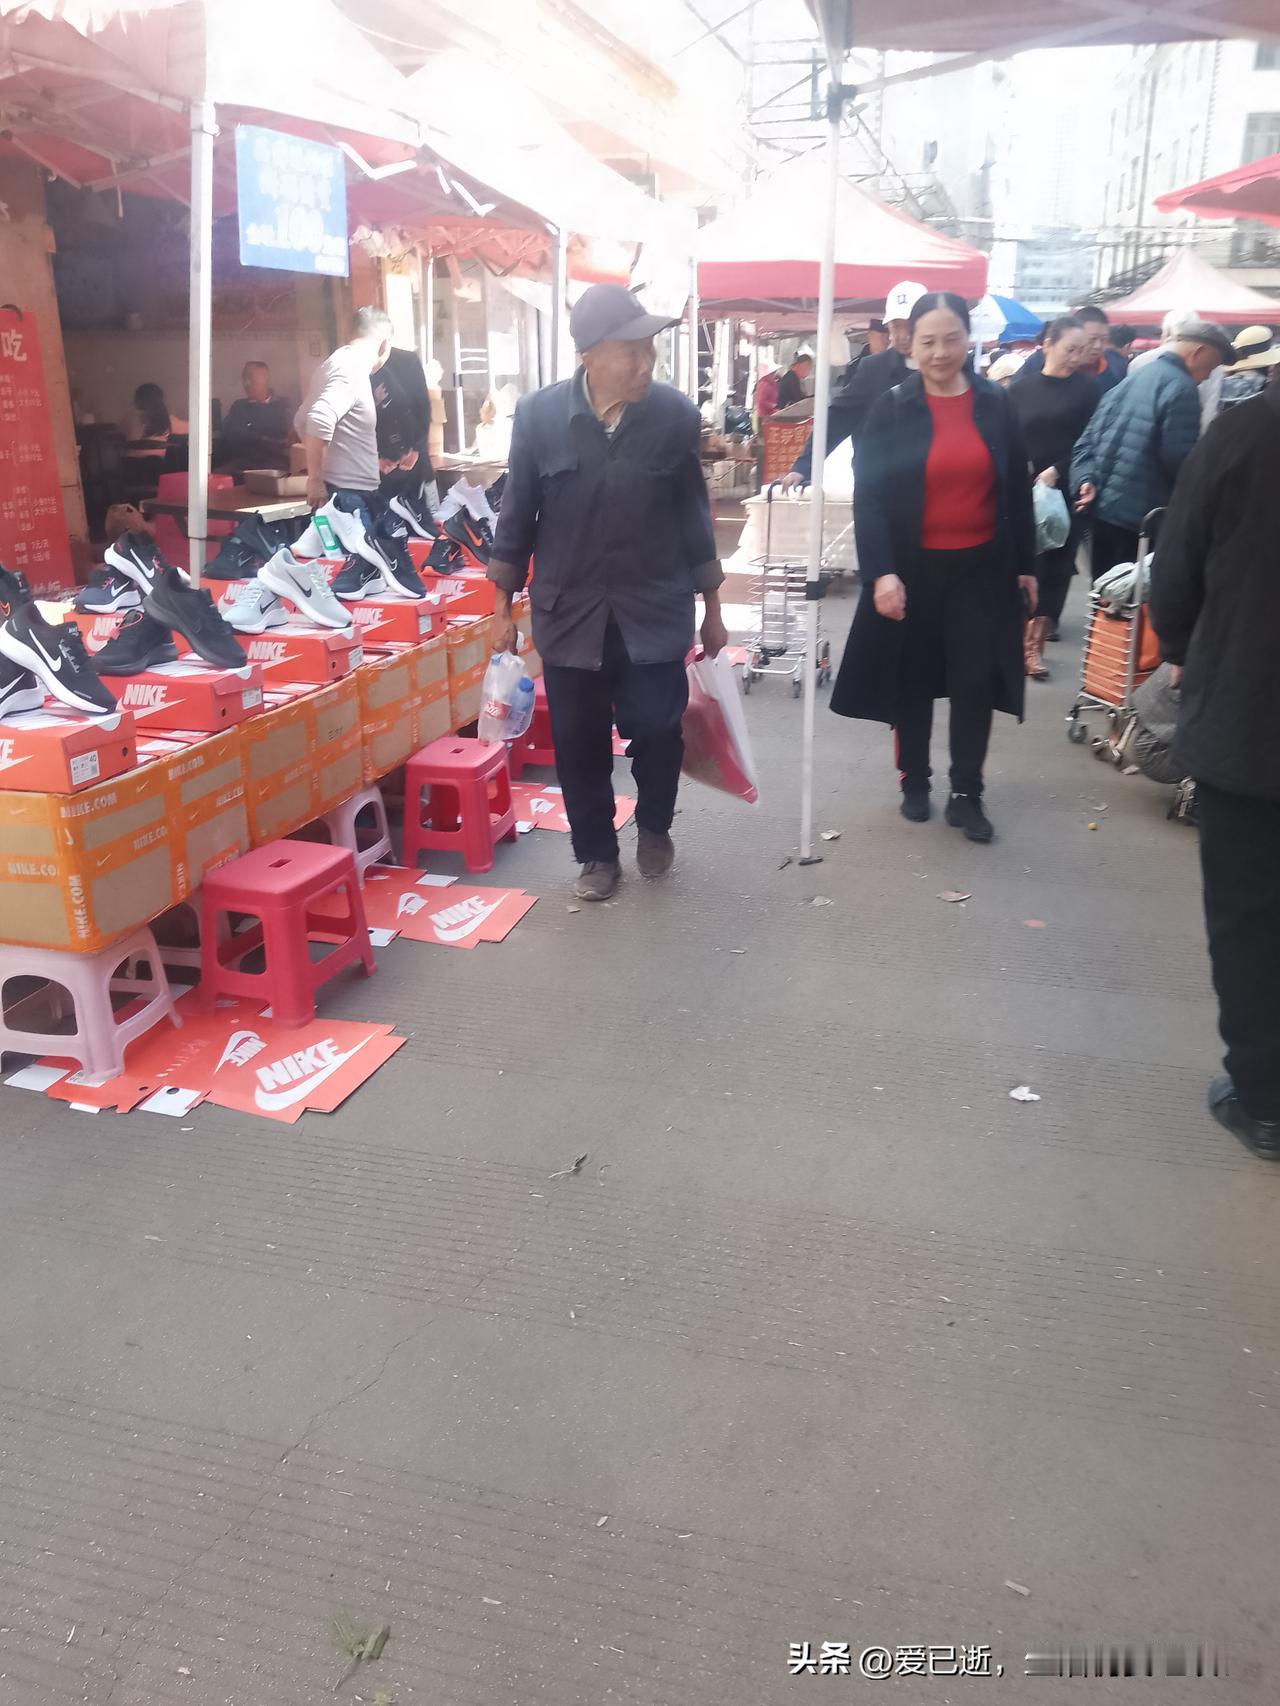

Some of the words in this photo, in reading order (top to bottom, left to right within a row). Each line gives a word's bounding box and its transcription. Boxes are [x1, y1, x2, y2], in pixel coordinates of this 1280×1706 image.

[1, 328, 27, 361] 吃
[352, 607, 384, 625] NIKE
[247, 641, 287, 660] NIKE
[123, 683, 168, 705] NIKE
[60, 792, 118, 818] NIKE.COM
[69, 874, 91, 939] NIKE.COM
[429, 895, 486, 929] NIKE
[256, 1038, 345, 1091] NIKE
